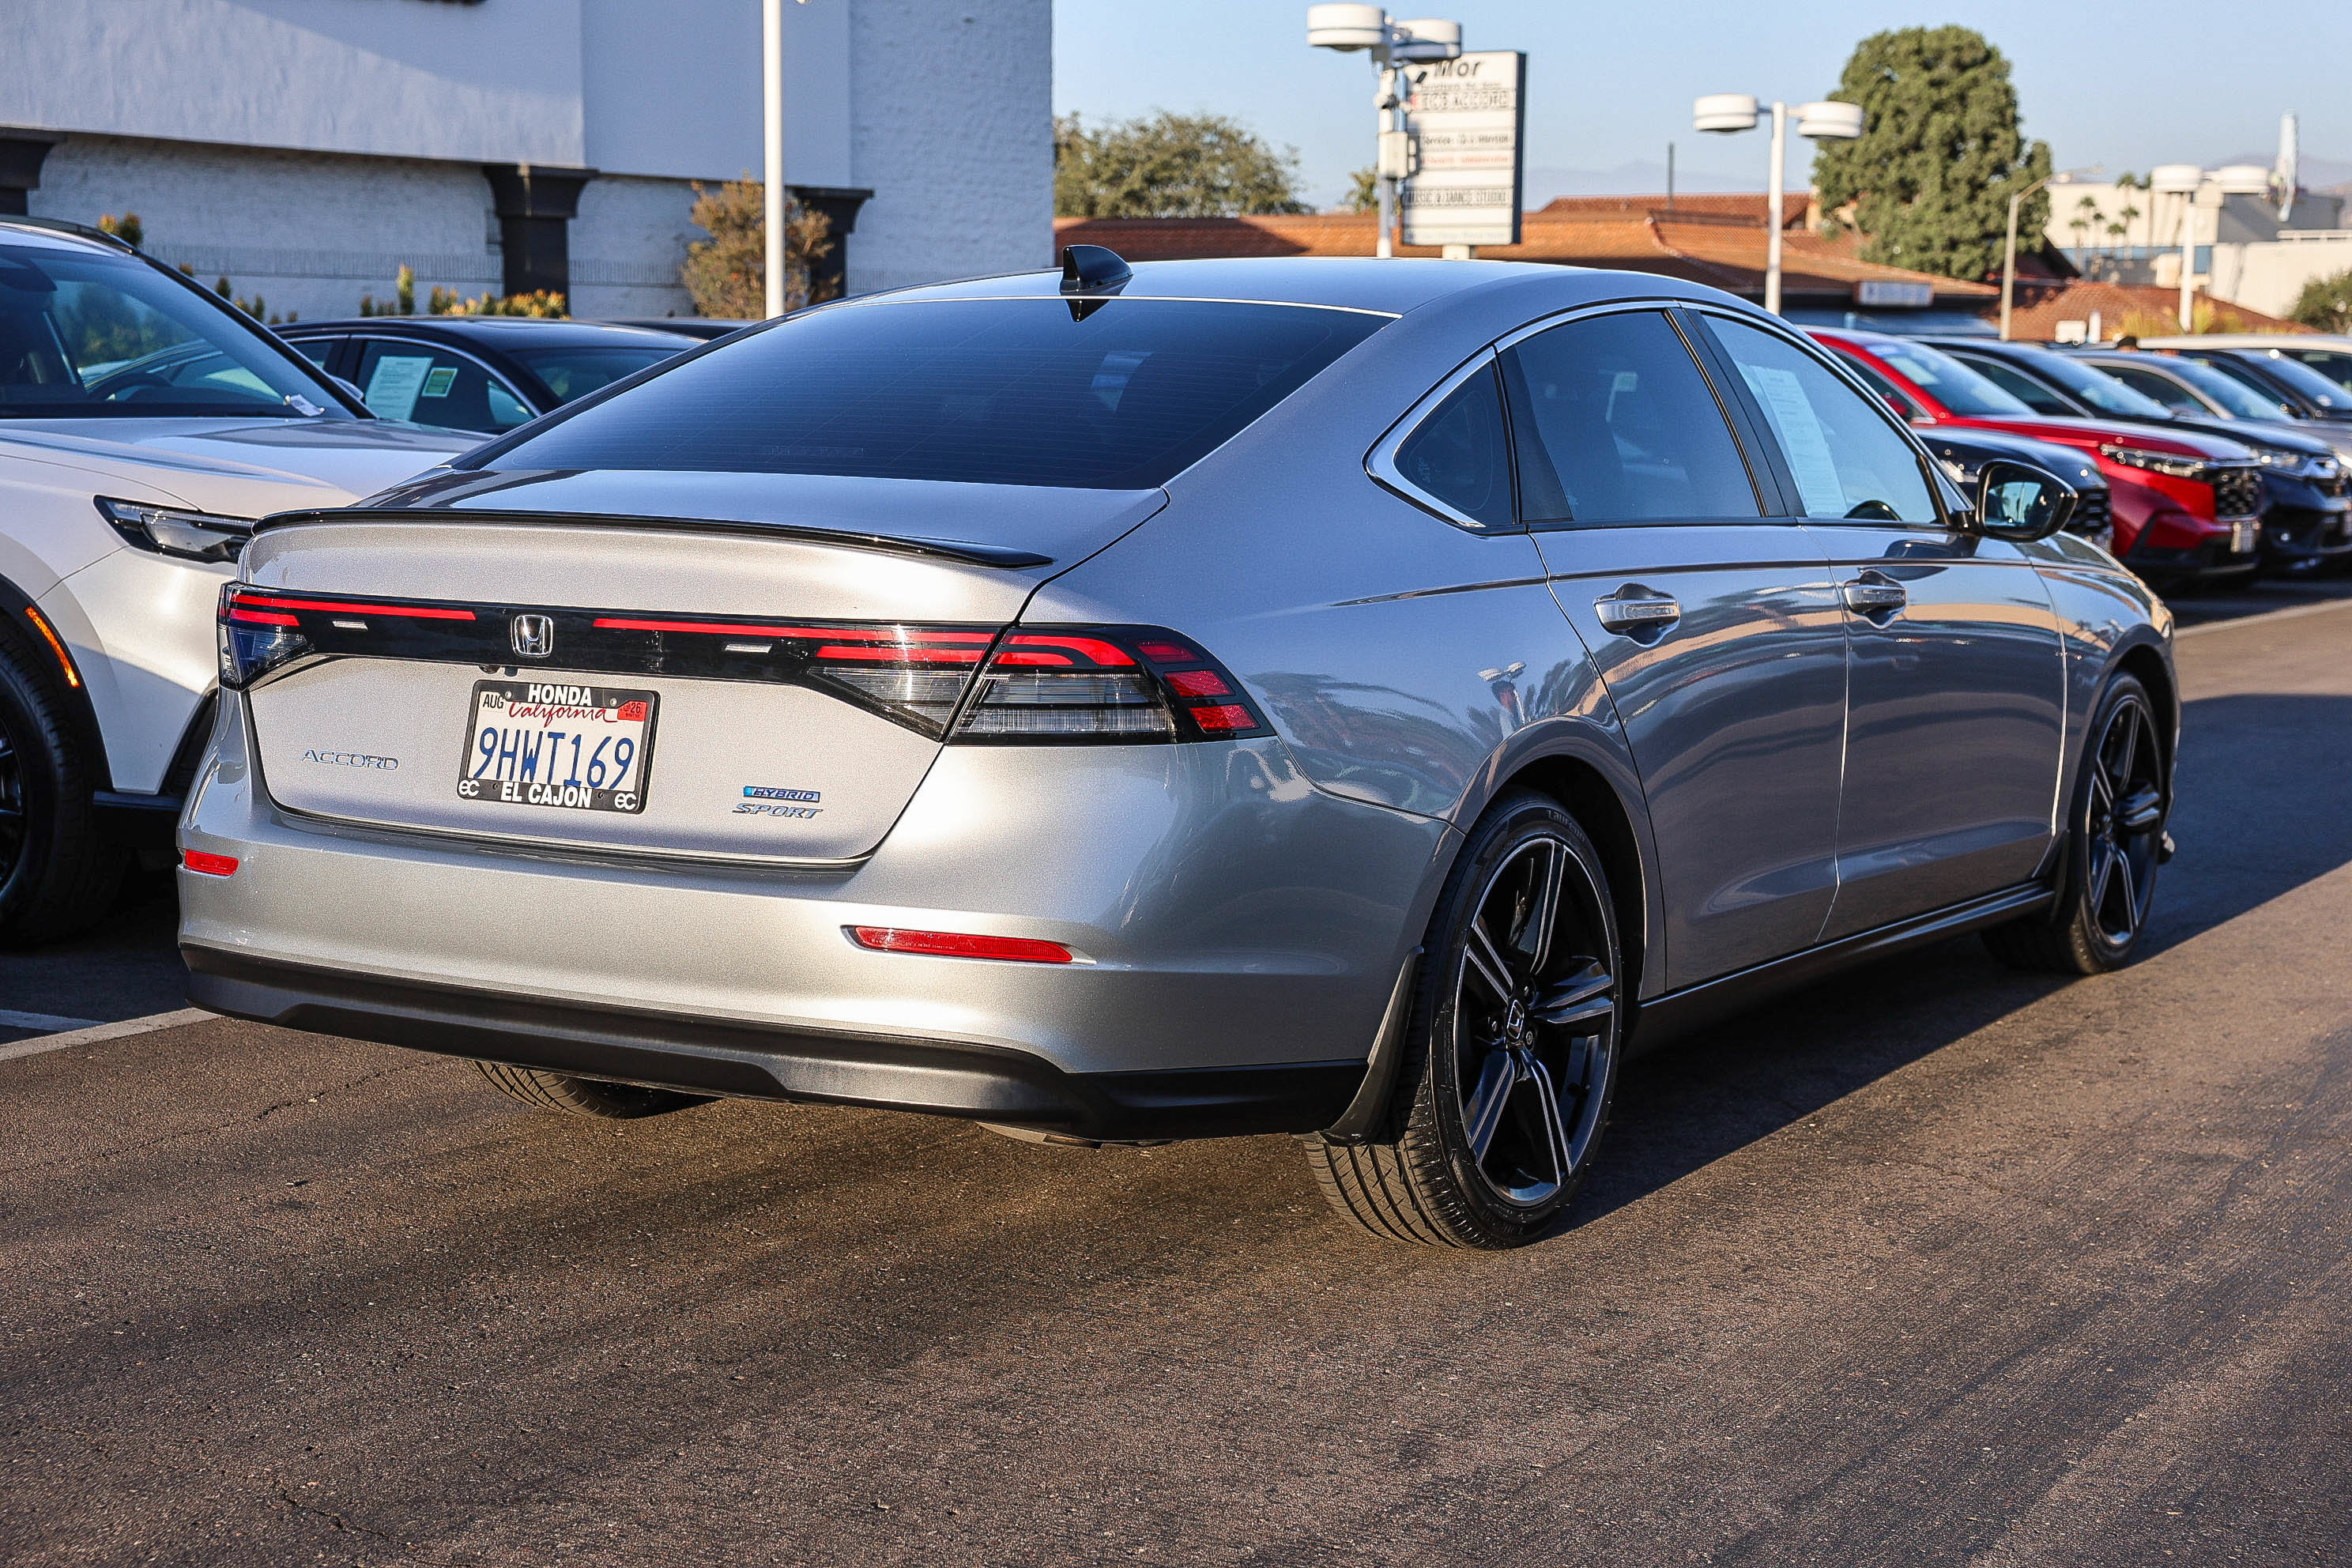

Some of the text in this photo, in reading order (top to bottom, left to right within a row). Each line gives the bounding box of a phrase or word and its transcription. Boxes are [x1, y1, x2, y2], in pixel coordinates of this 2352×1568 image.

[483, 693, 504, 710] AUG
[527, 684, 593, 707] HONDA
[508, 701, 618, 728] California
[630, 702, 642, 714] 26
[300, 749, 400, 771] ACCORD
[473, 727, 635, 790] 9HWT169
[500, 782, 593, 808] EL CAJON
[752, 787, 816, 801] HYBRID
[732, 802, 824, 819] SPORT
